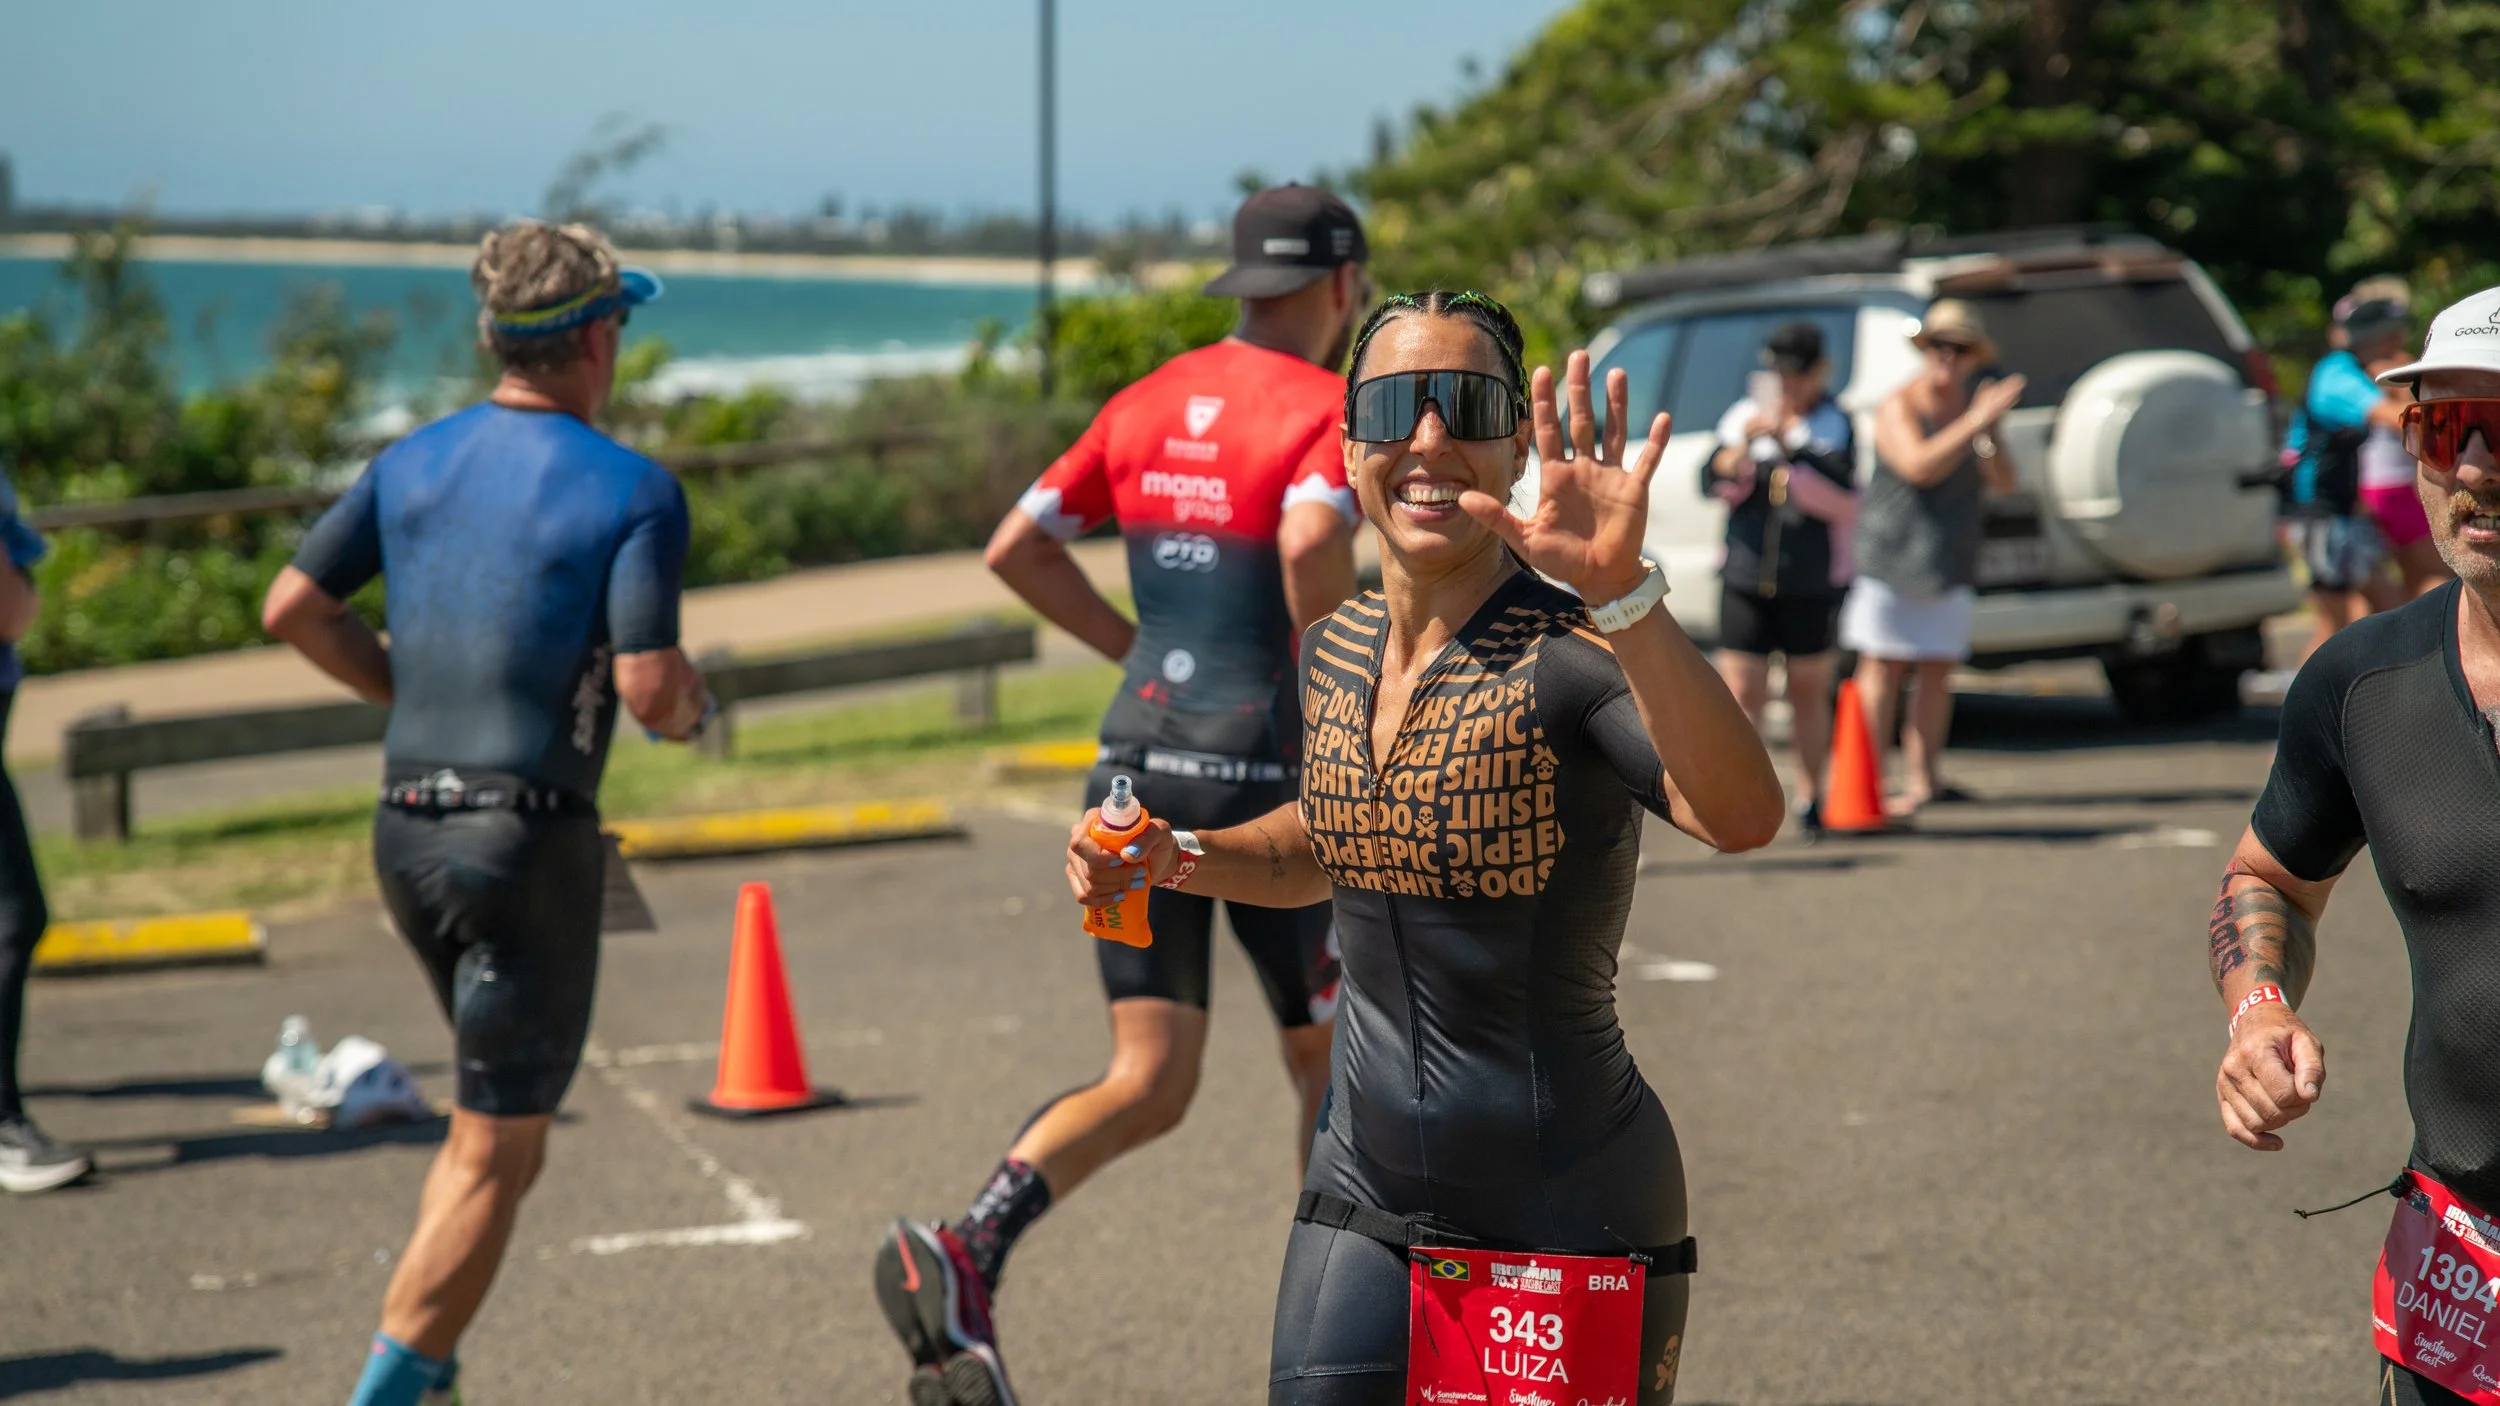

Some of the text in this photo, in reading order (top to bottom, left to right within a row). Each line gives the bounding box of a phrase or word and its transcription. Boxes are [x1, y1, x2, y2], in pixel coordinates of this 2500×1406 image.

[2455, 325, 2499, 337] Gooch
[1140, 470, 1227, 502] mana
[1172, 498, 1234, 525] group
[1324, 686, 1357, 725] DO
[1315, 722, 1364, 765] EPIC
[1451, 705, 1527, 753] EPIC
[1310, 758, 1370, 800] SHIT.
[1392, 770, 1439, 802] DO
[1443, 748, 1535, 791] SHIT.
[1439, 789, 1532, 830] SHIT.
[1446, 828, 1533, 867] EPIC
[1479, 865, 1535, 898] DO
[1490, 1259, 1562, 1282] IRONMAN
[1491, 1275, 1518, 1290] 70.3
[1588, 1274, 1629, 1291] BRA
[2418, 1246, 2500, 1314] 1394
[1489, 1306, 1564, 1351] 343
[2397, 1281, 2488, 1349] DANIEL
[1484, 1347, 1569, 1384] LUIZA
[2472, 1364, 2500, 1389] Queens
[1437, 1390, 1487, 1402] Sunshine Coast
